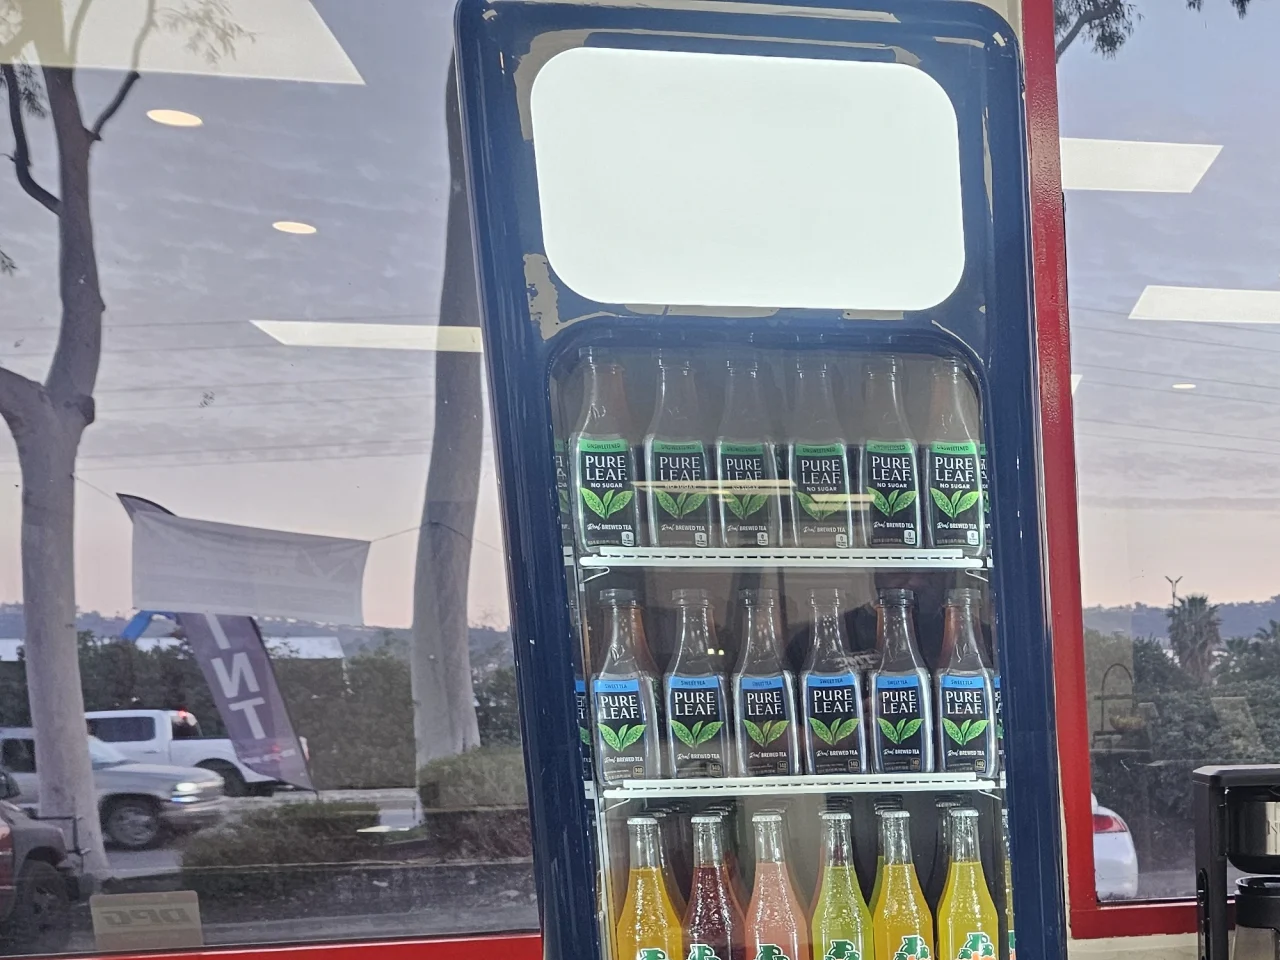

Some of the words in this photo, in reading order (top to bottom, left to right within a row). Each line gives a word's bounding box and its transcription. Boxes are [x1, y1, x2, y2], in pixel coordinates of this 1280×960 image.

[586, 456, 626, 468] PURE
[660, 456, 700, 469] PURE
[726, 458, 762, 470] PURE
[801, 460, 840, 472] PURE
[872, 456, 910, 469] PURE
[935, 457, 974, 469] PURE
[601, 694, 638, 708] PURE
[674, 692, 714, 704] PURE
[747, 692, 782, 704] PURE
[814, 689, 852, 702] PURE
[882, 690, 916, 702] PURE
[946, 690, 982, 703] PURE
